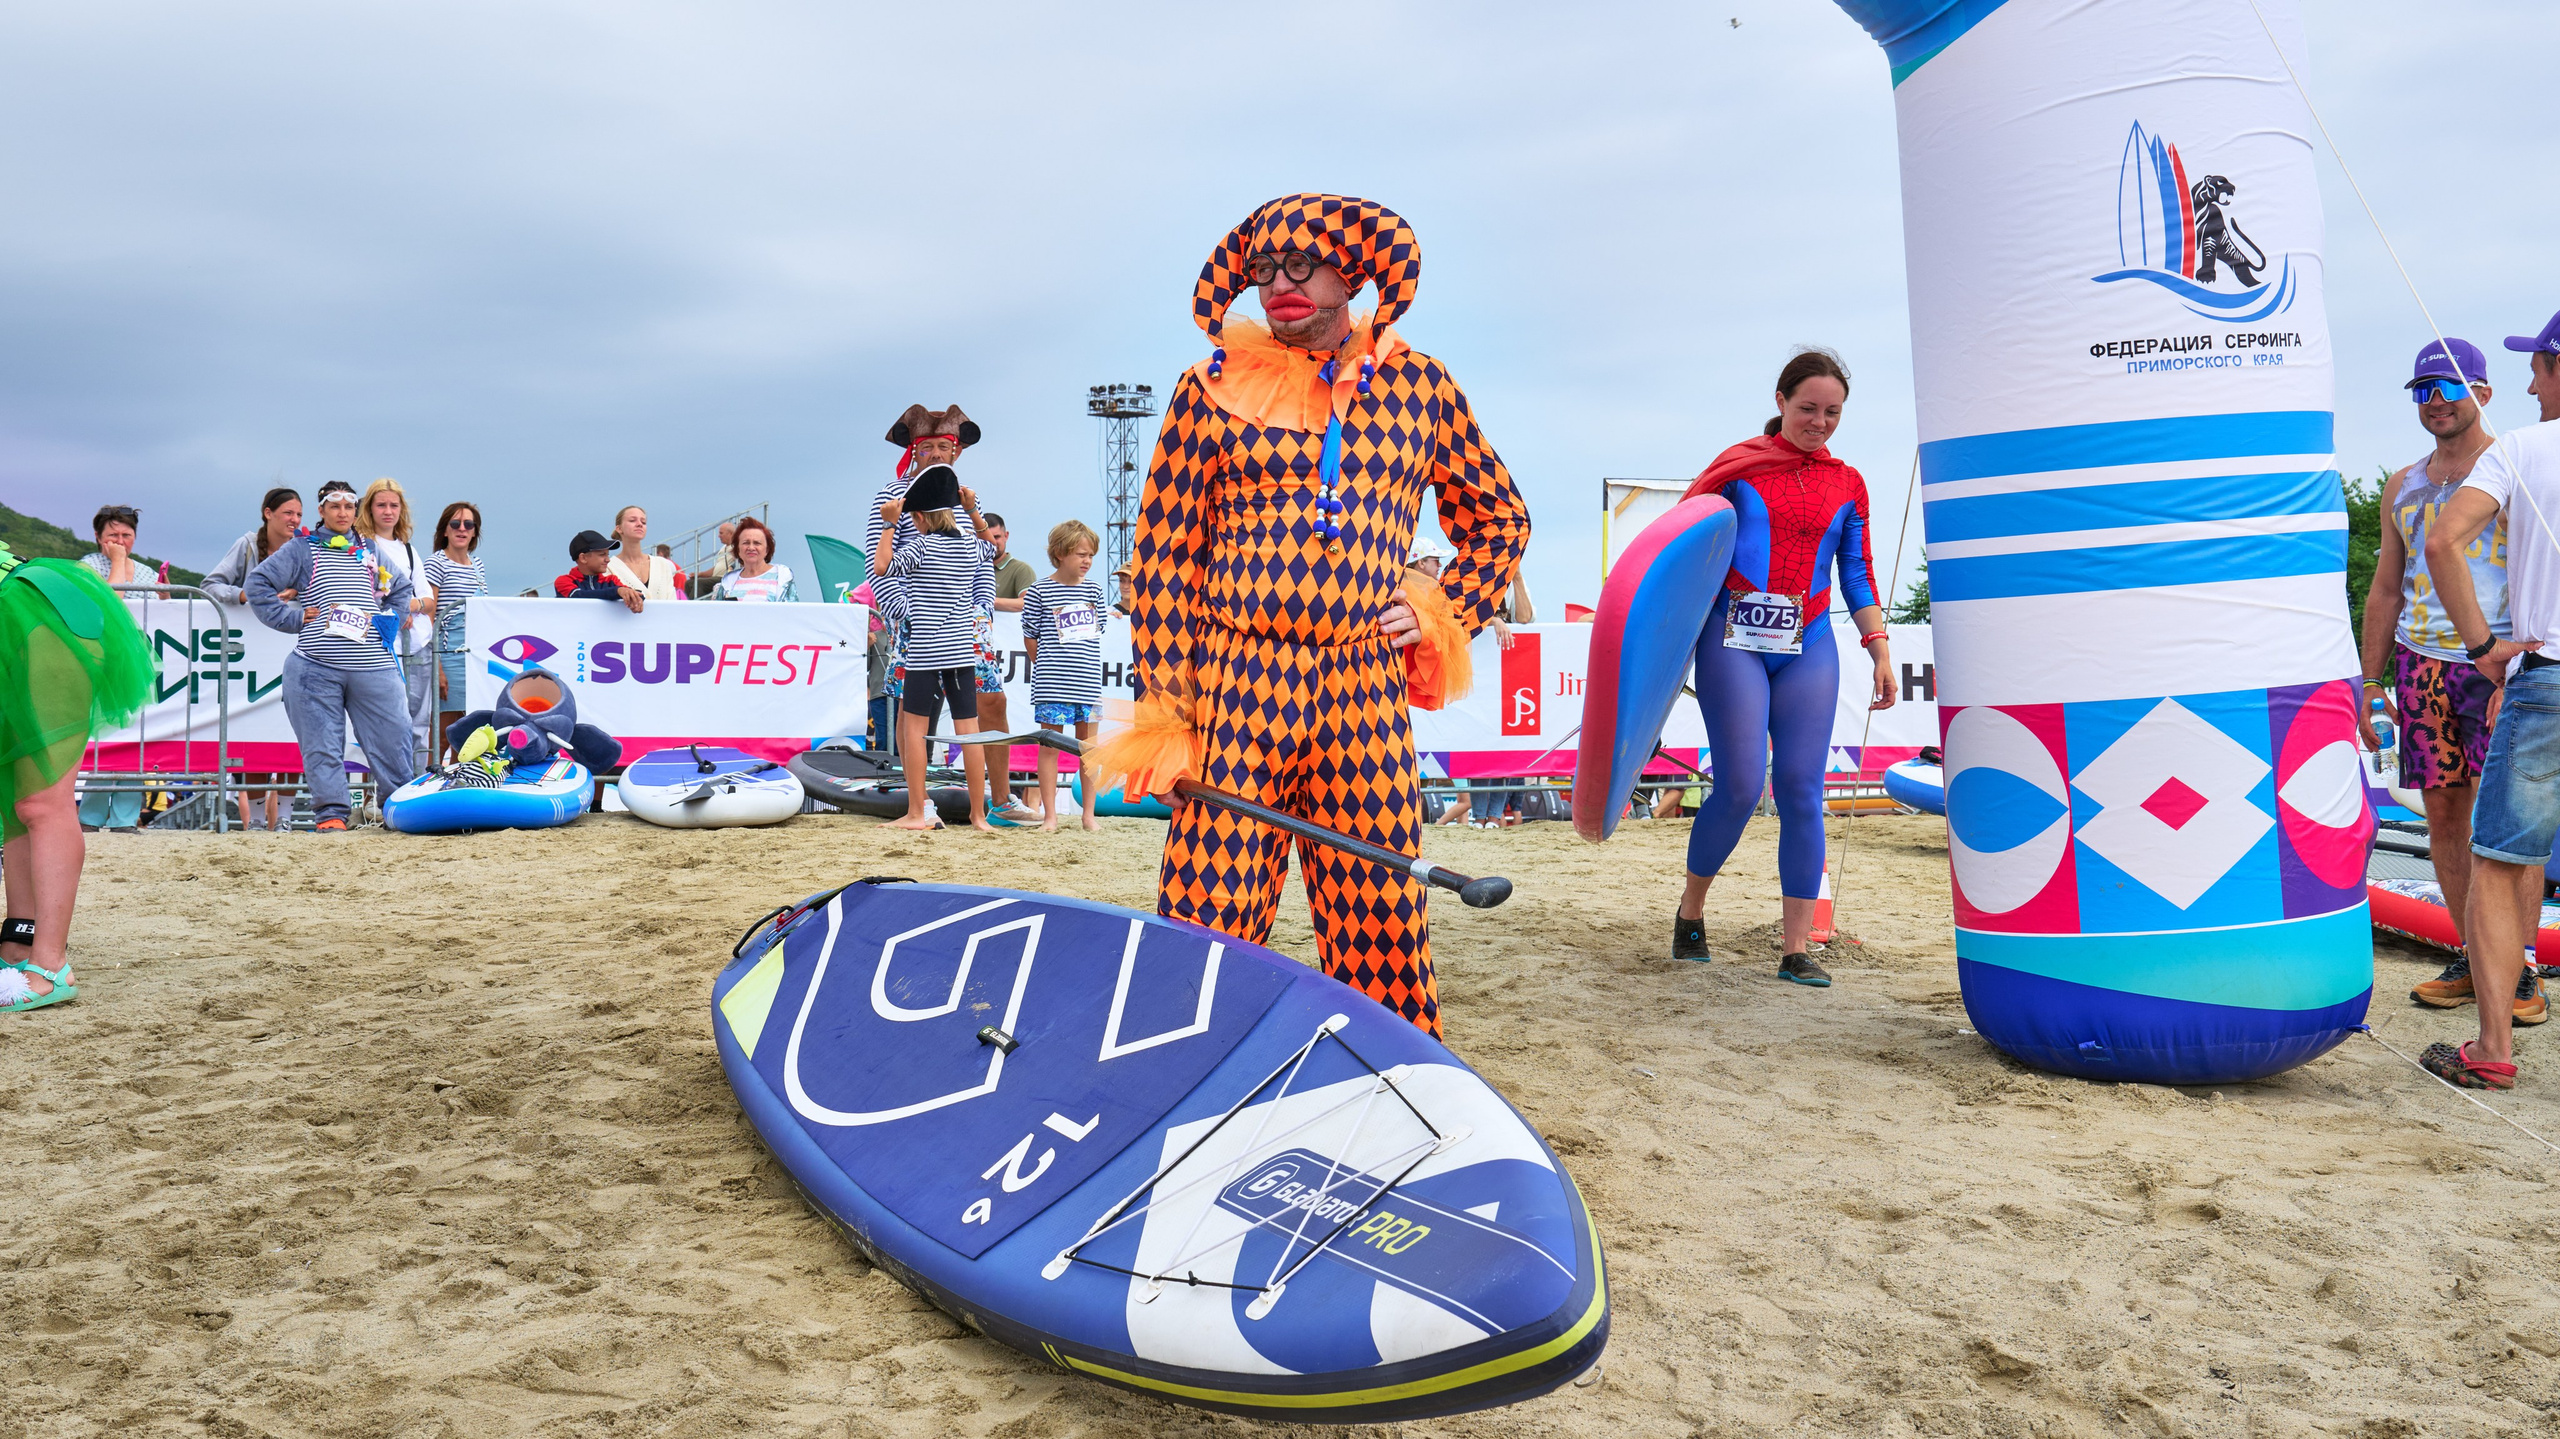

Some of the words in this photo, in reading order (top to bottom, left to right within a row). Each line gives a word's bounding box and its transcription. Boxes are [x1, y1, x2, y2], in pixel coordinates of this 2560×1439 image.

[2090, 335, 2212, 358] ФЕДЕРАЦИЯ
[2225, 333, 2302, 349] СЕРФИНГА
[2127, 354, 2242, 374] ПРИМОРСКОГО
[2253, 353, 2284, 366] КРАЯ
[1347, 1210, 1432, 1256] PRO
